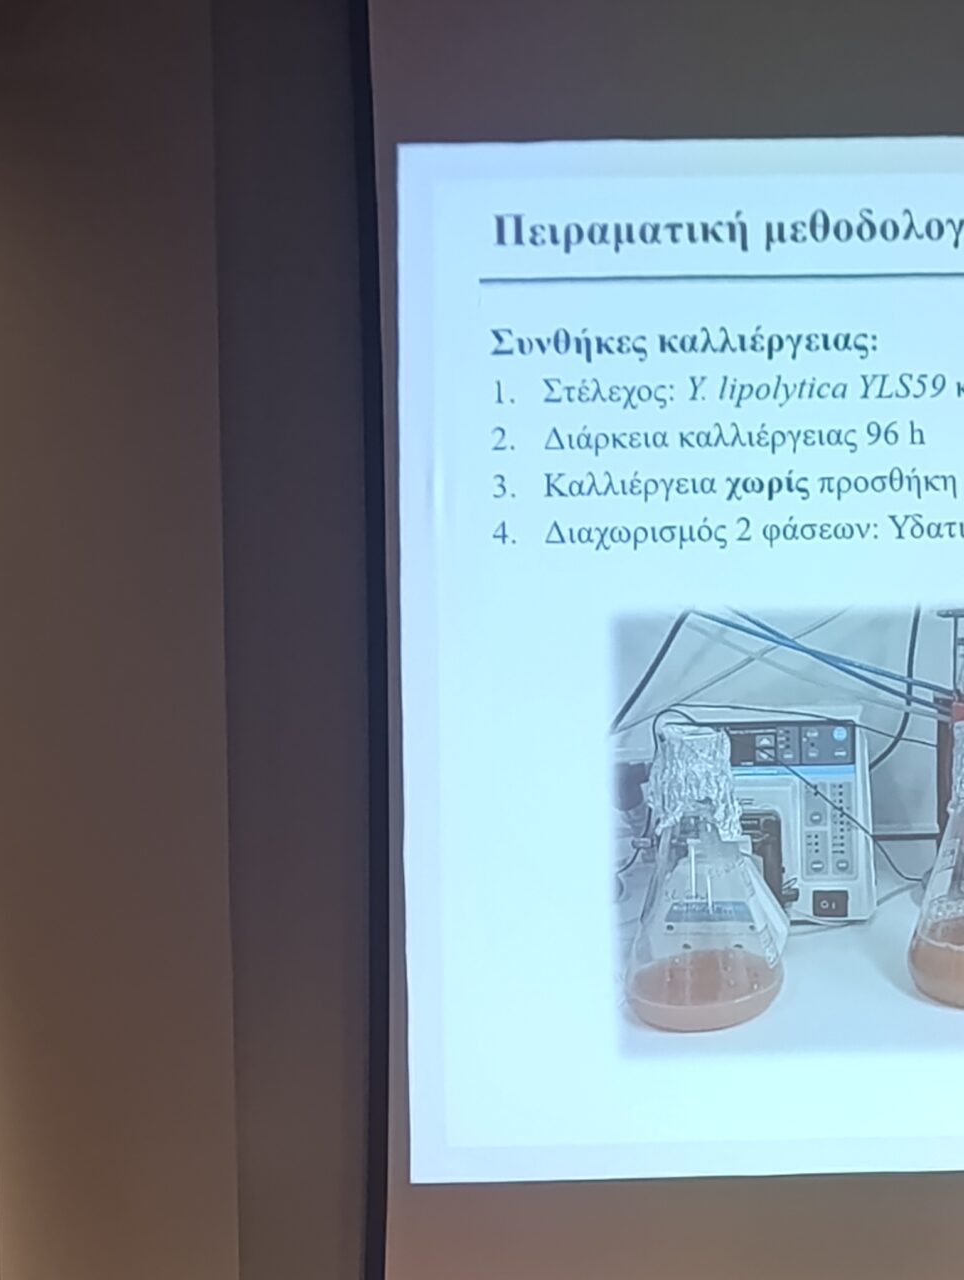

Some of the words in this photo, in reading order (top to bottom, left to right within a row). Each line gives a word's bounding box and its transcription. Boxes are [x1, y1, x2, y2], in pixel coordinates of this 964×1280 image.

[493, 209, 748, 254] Πειραματική
[765, 207, 964, 252] μεθοδολογ
[490, 327, 648, 363] Συνθήκες
[658, 325, 878, 361] καλλιέργειας:
[494, 379, 516, 404] 1.
[542, 377, 676, 410] Στέλεχος:
[688, 375, 707, 401] Y.
[718, 374, 849, 408] lipolytica
[859, 372, 947, 399] YLS59
[491, 426, 516, 451] 2.
[544, 425, 669, 457] Διάρκεια
[679, 421, 859, 456] καλλιέργειας
[866, 420, 900, 446] 96
[909, 420, 926, 446] h
[493, 473, 516, 499] 3.
[543, 471, 717, 503] Καλλιέργεια
[726, 469, 811, 501] χωρίς
[818, 466, 958, 500] προσθήκη
[492, 520, 517, 545] 4.
[545, 517, 728, 550] Διαχωρισμός
[736, 516, 752, 542] 2
[762, 515, 879, 549] φάσεων:
